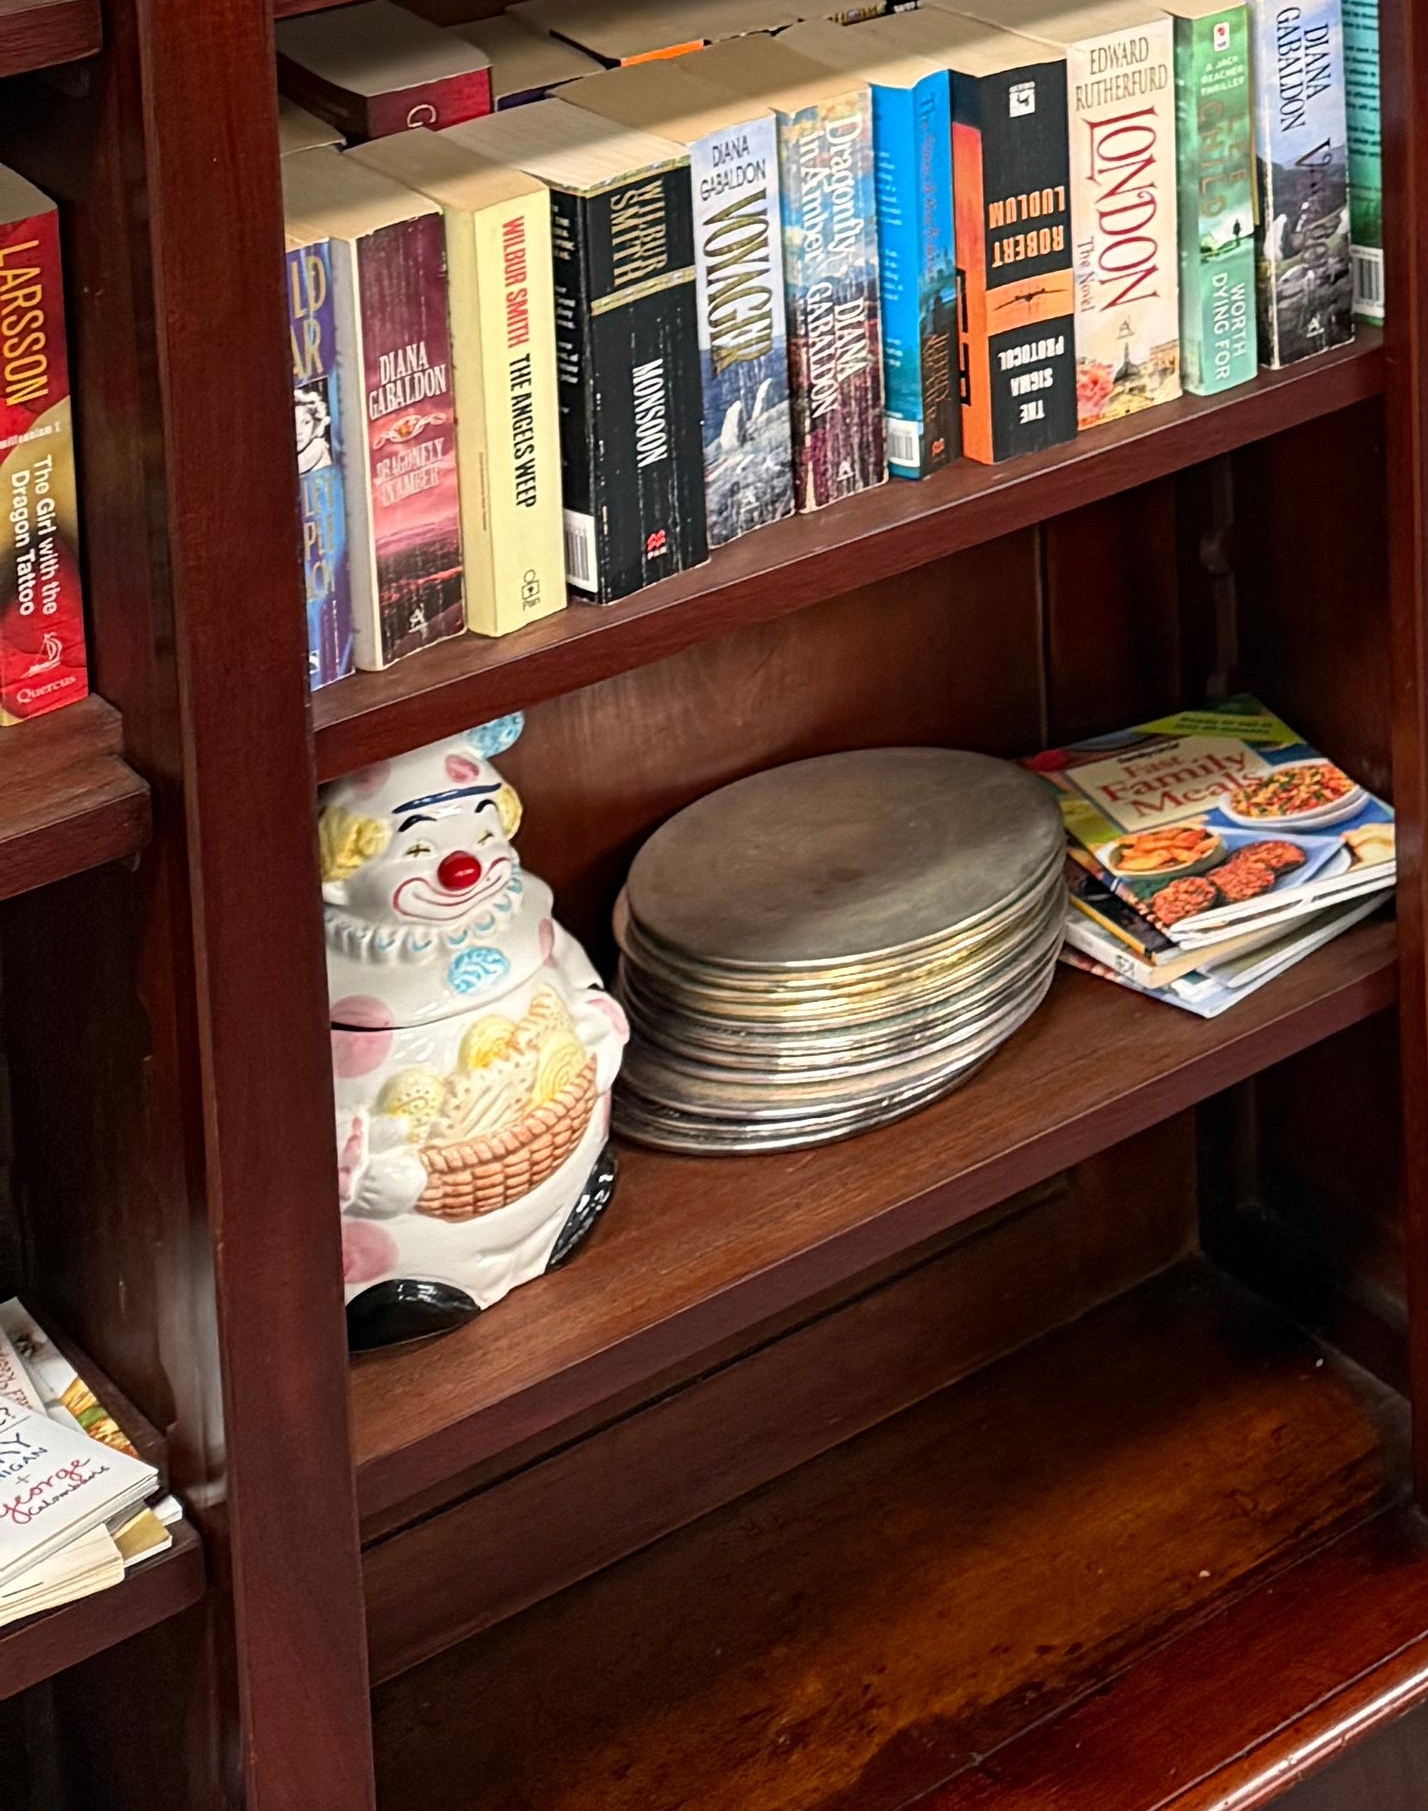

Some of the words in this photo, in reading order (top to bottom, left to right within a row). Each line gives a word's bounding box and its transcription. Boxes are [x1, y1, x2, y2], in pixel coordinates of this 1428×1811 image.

[1089, 36, 1149, 76] EDWARD
[1276, 6, 1306, 133] GABALDON
[1304, 23, 1332, 101] DIANA
[1075, 64, 1168, 112] RUTHERFURD
[700, 158, 767, 201] GABALDON
[712, 134, 750, 168] DIANA
[988, 185, 1066, 229] LUDLUM
[1080, 105, 1160, 312] LONDON
[501, 215, 527, 288] WILBUR
[990, 225, 1065, 268] ROBERT
[702, 188, 774, 375] VOYAGER
[1212, 273, 1230, 335] DYING
[0, 239, 49, 406] LARSSON
[505, 288, 530, 349] SMITH
[835, 297, 867, 383] DIANA
[1229, 283, 1248, 358] WORTH
[378, 340, 430, 385] DIANA
[508, 353, 532, 393] THE
[805, 281, 840, 419] GABALDON
[1214, 339, 1231, 380] FOR
[368, 363, 447, 421] GABALDON
[632, 358, 668, 468] MONSOON
[511, 393, 536, 461] ANGELS
[9, 470, 30, 548] Dragon
[514, 461, 538, 508] WEEP
[16, 548, 36, 616] Tattoo
[16, 675, 77, 705] Quercus
[1097, 751, 1246, 803] Family
[1128, 771, 1266, 818] Meals
